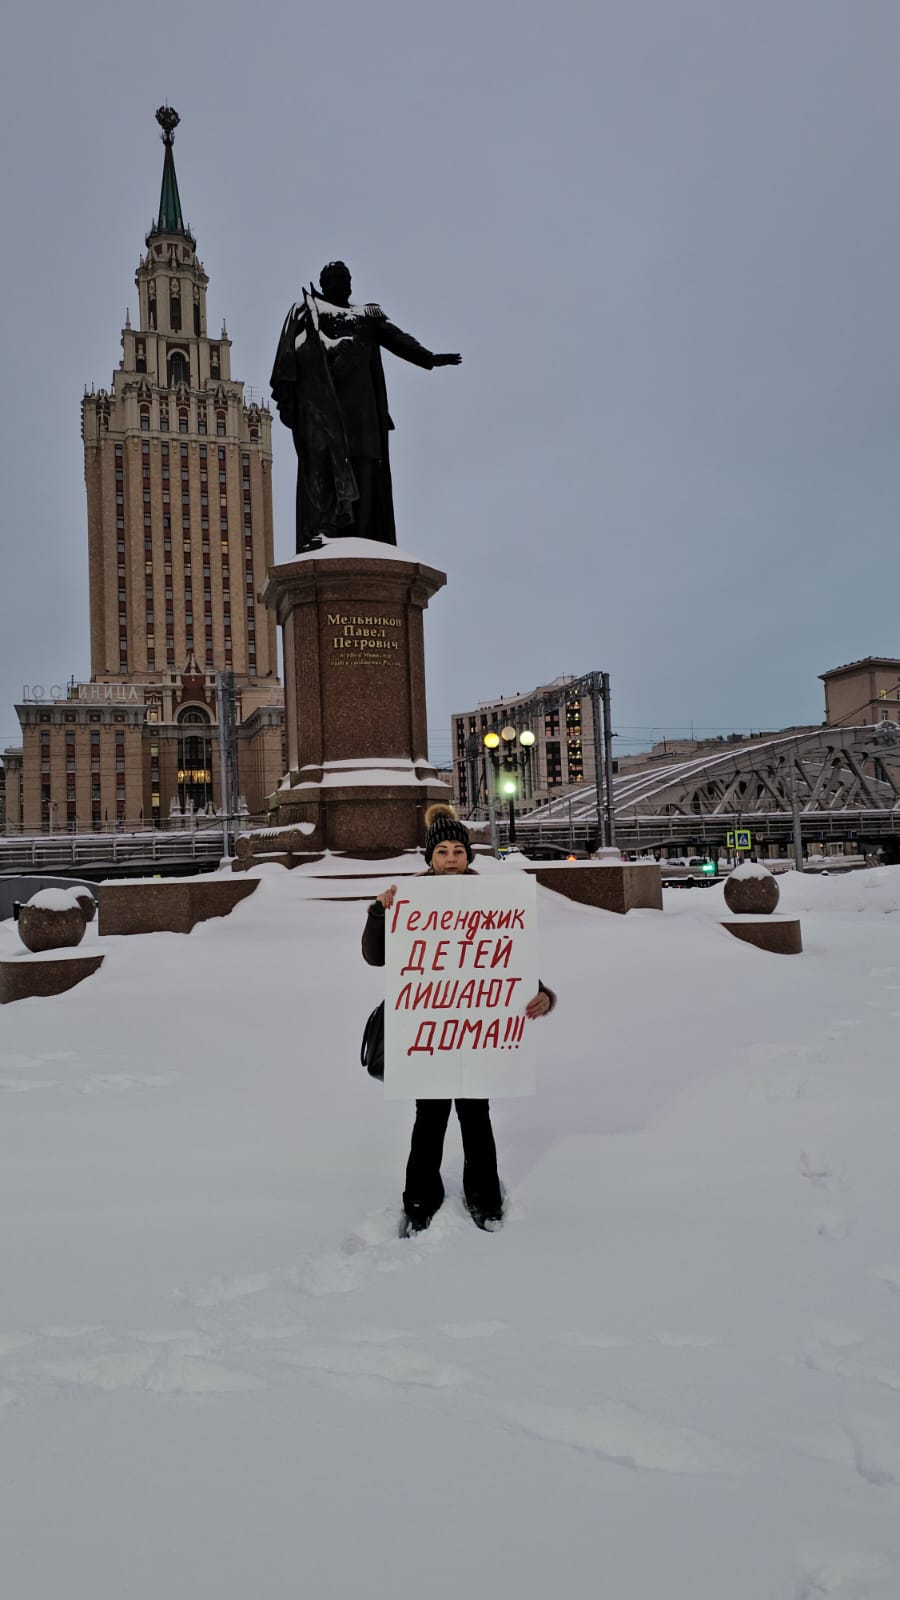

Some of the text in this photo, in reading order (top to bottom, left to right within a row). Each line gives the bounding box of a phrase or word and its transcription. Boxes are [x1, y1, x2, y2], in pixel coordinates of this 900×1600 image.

[327, 614, 402, 627] Мельников
[343, 625, 386, 638] Павел
[333, 637, 399, 650] Петрович
[390, 899, 526, 940] Геленджик
[400, 935, 513, 976] ДЕТЕЙ
[395, 977, 522, 1010] ЛИШАЮТ
[407, 1015, 526, 1056] ДОМА!!!
